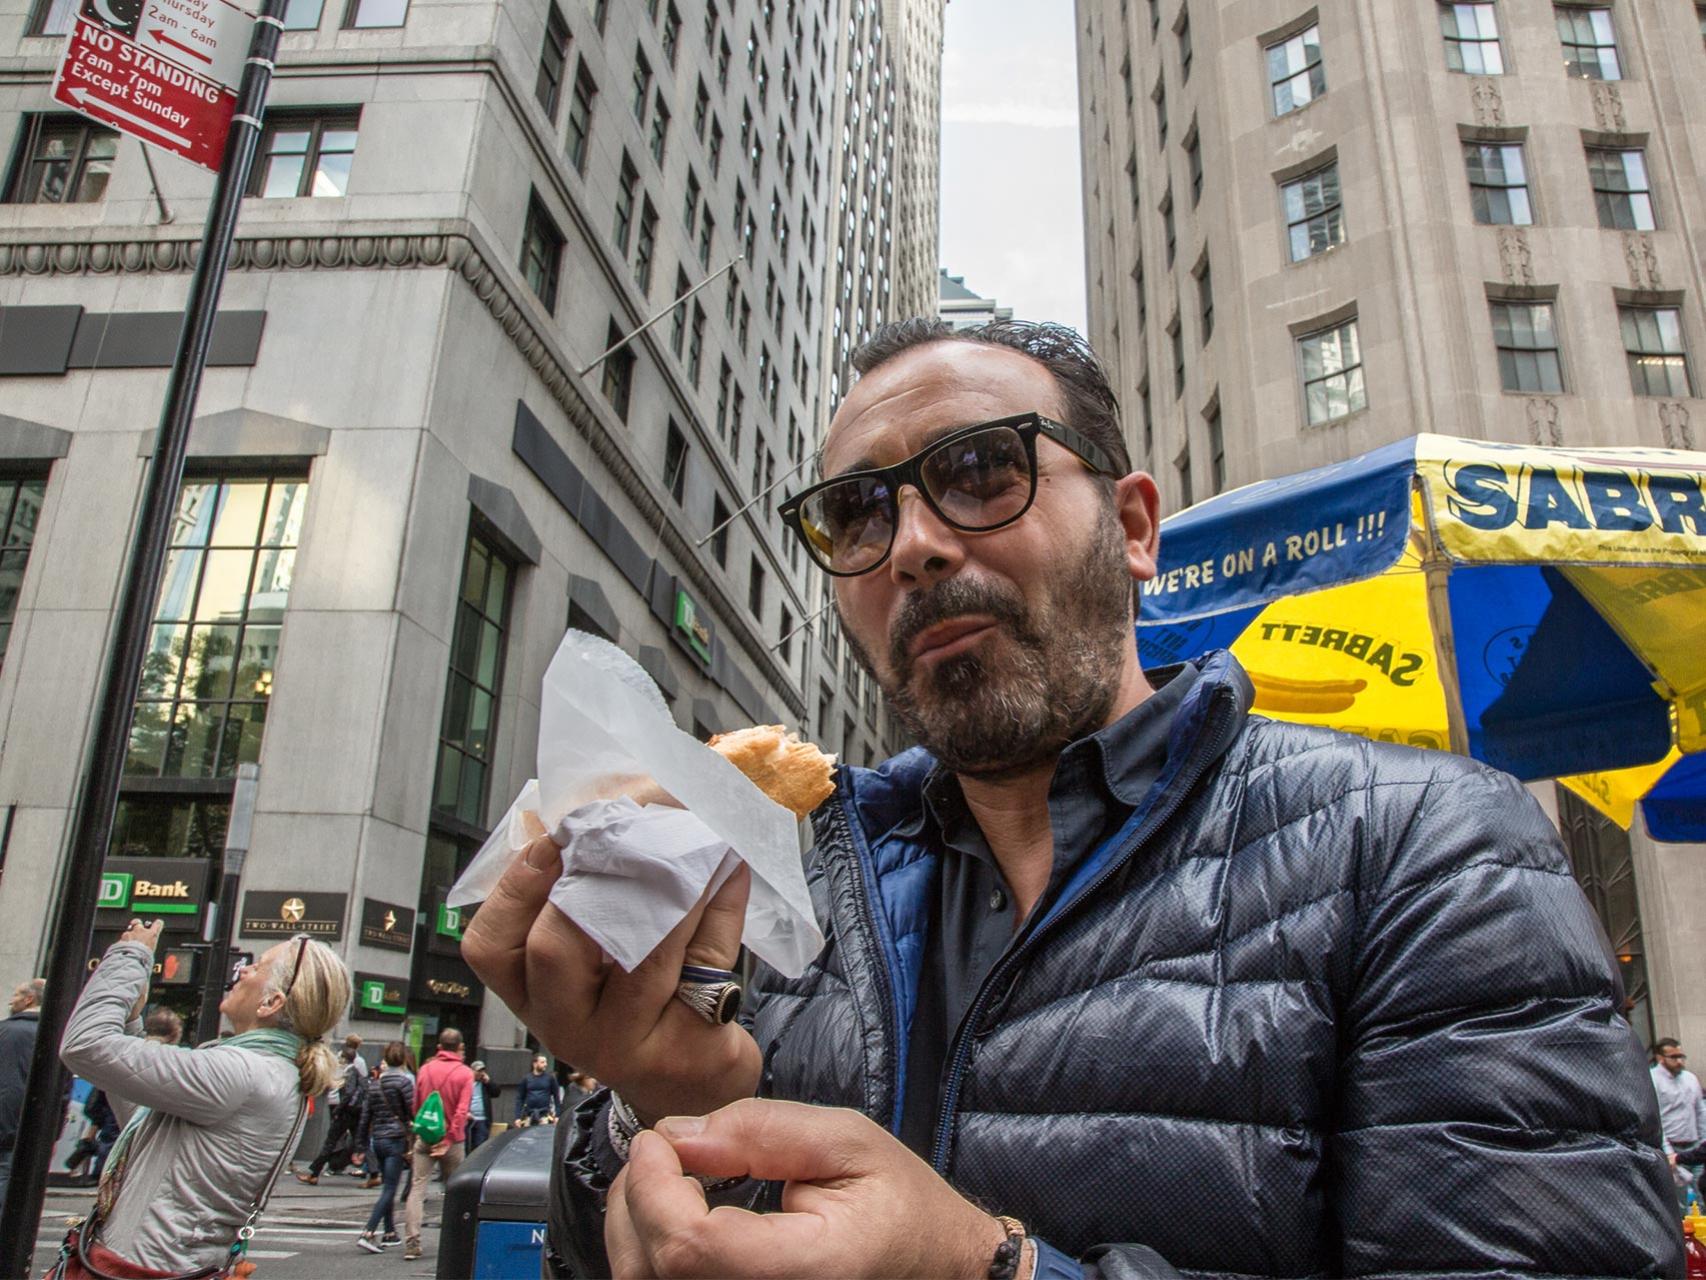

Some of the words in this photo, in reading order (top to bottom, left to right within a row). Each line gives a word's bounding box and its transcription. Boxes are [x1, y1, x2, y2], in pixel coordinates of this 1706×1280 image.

[148, 5, 178, 28] 2am
[190, 28, 217, 48] 6am
[162, 0, 215, 28] ursday
[78, 46, 113, 74] 7am
[128, 69, 162, 97] 7pm
[81, 25, 114, 52] NO
[118, 44, 219, 104] STANDING
[71, 61, 129, 99] Except
[132, 91, 190, 129] Sunday
[1143, 560, 1214, 596] WE'RE
[1222, 548, 1254, 578] ON
[1262, 542, 1277, 567] A
[1285, 523, 1347, 561] ROLL
[1356, 511, 1386, 542] !!!
[134, 880, 189, 898] Bank
[245, 921, 267, 930] TWO
[272, 922, 297, 931] WALL
[301, 923, 337, 931] STREET
[369, 986, 383, 1004] TD
